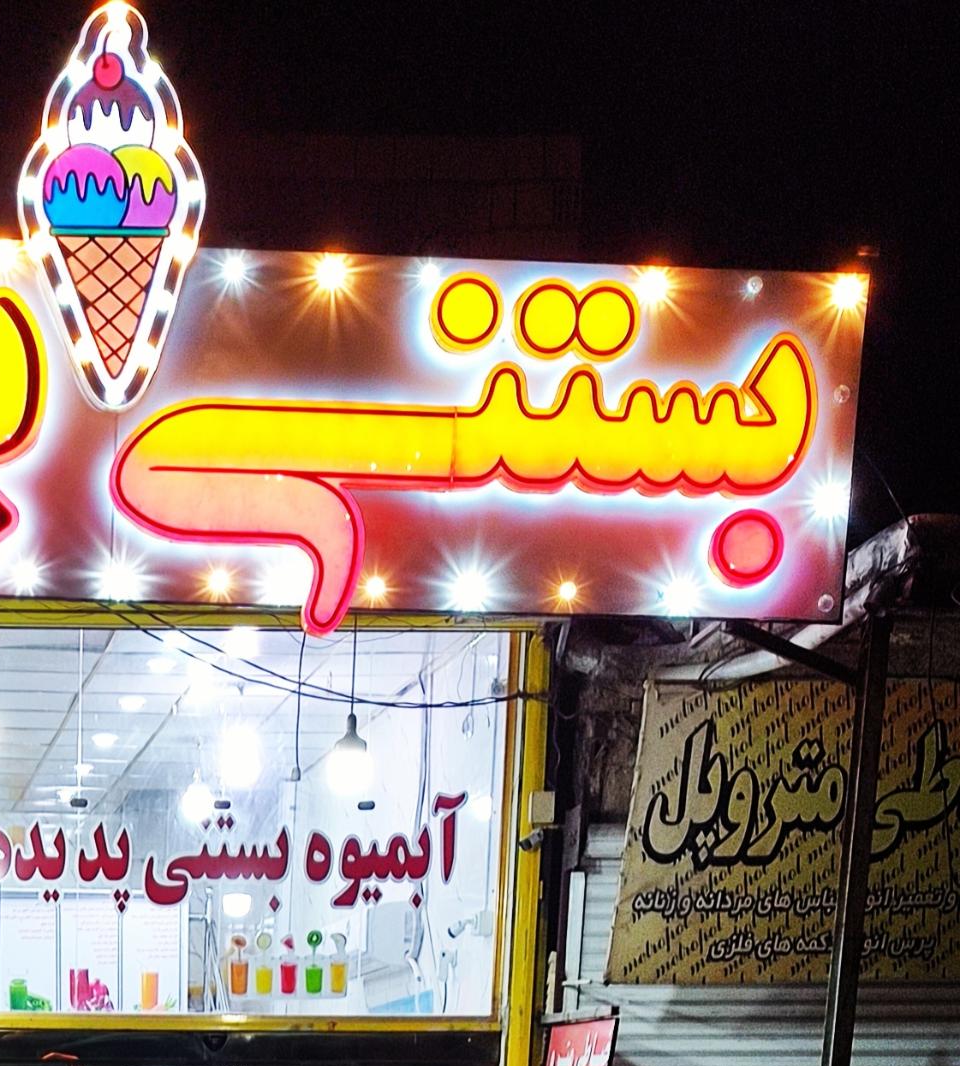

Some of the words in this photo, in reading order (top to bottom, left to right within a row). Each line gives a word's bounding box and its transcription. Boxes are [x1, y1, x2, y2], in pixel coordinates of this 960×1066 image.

[110, 270, 817, 635] بستنی
[642, 719, 847, 871] متروپل
[144, 814, 290, 912] بستنی
[305, 791, 468, 910] آبمیوه
[633, 888, 677, 918] زنانه
[695, 890, 752, 914] مردانه
[757, 889, 791, 915] های
[796, 889, 839, 914] باس
[865, 889, 890, 914] انو
[710, 934, 753, 959] فلزی
[756, 933, 791, 958] های
[796, 934, 835, 953] کمه
[863, 933, 886, 953] انو
